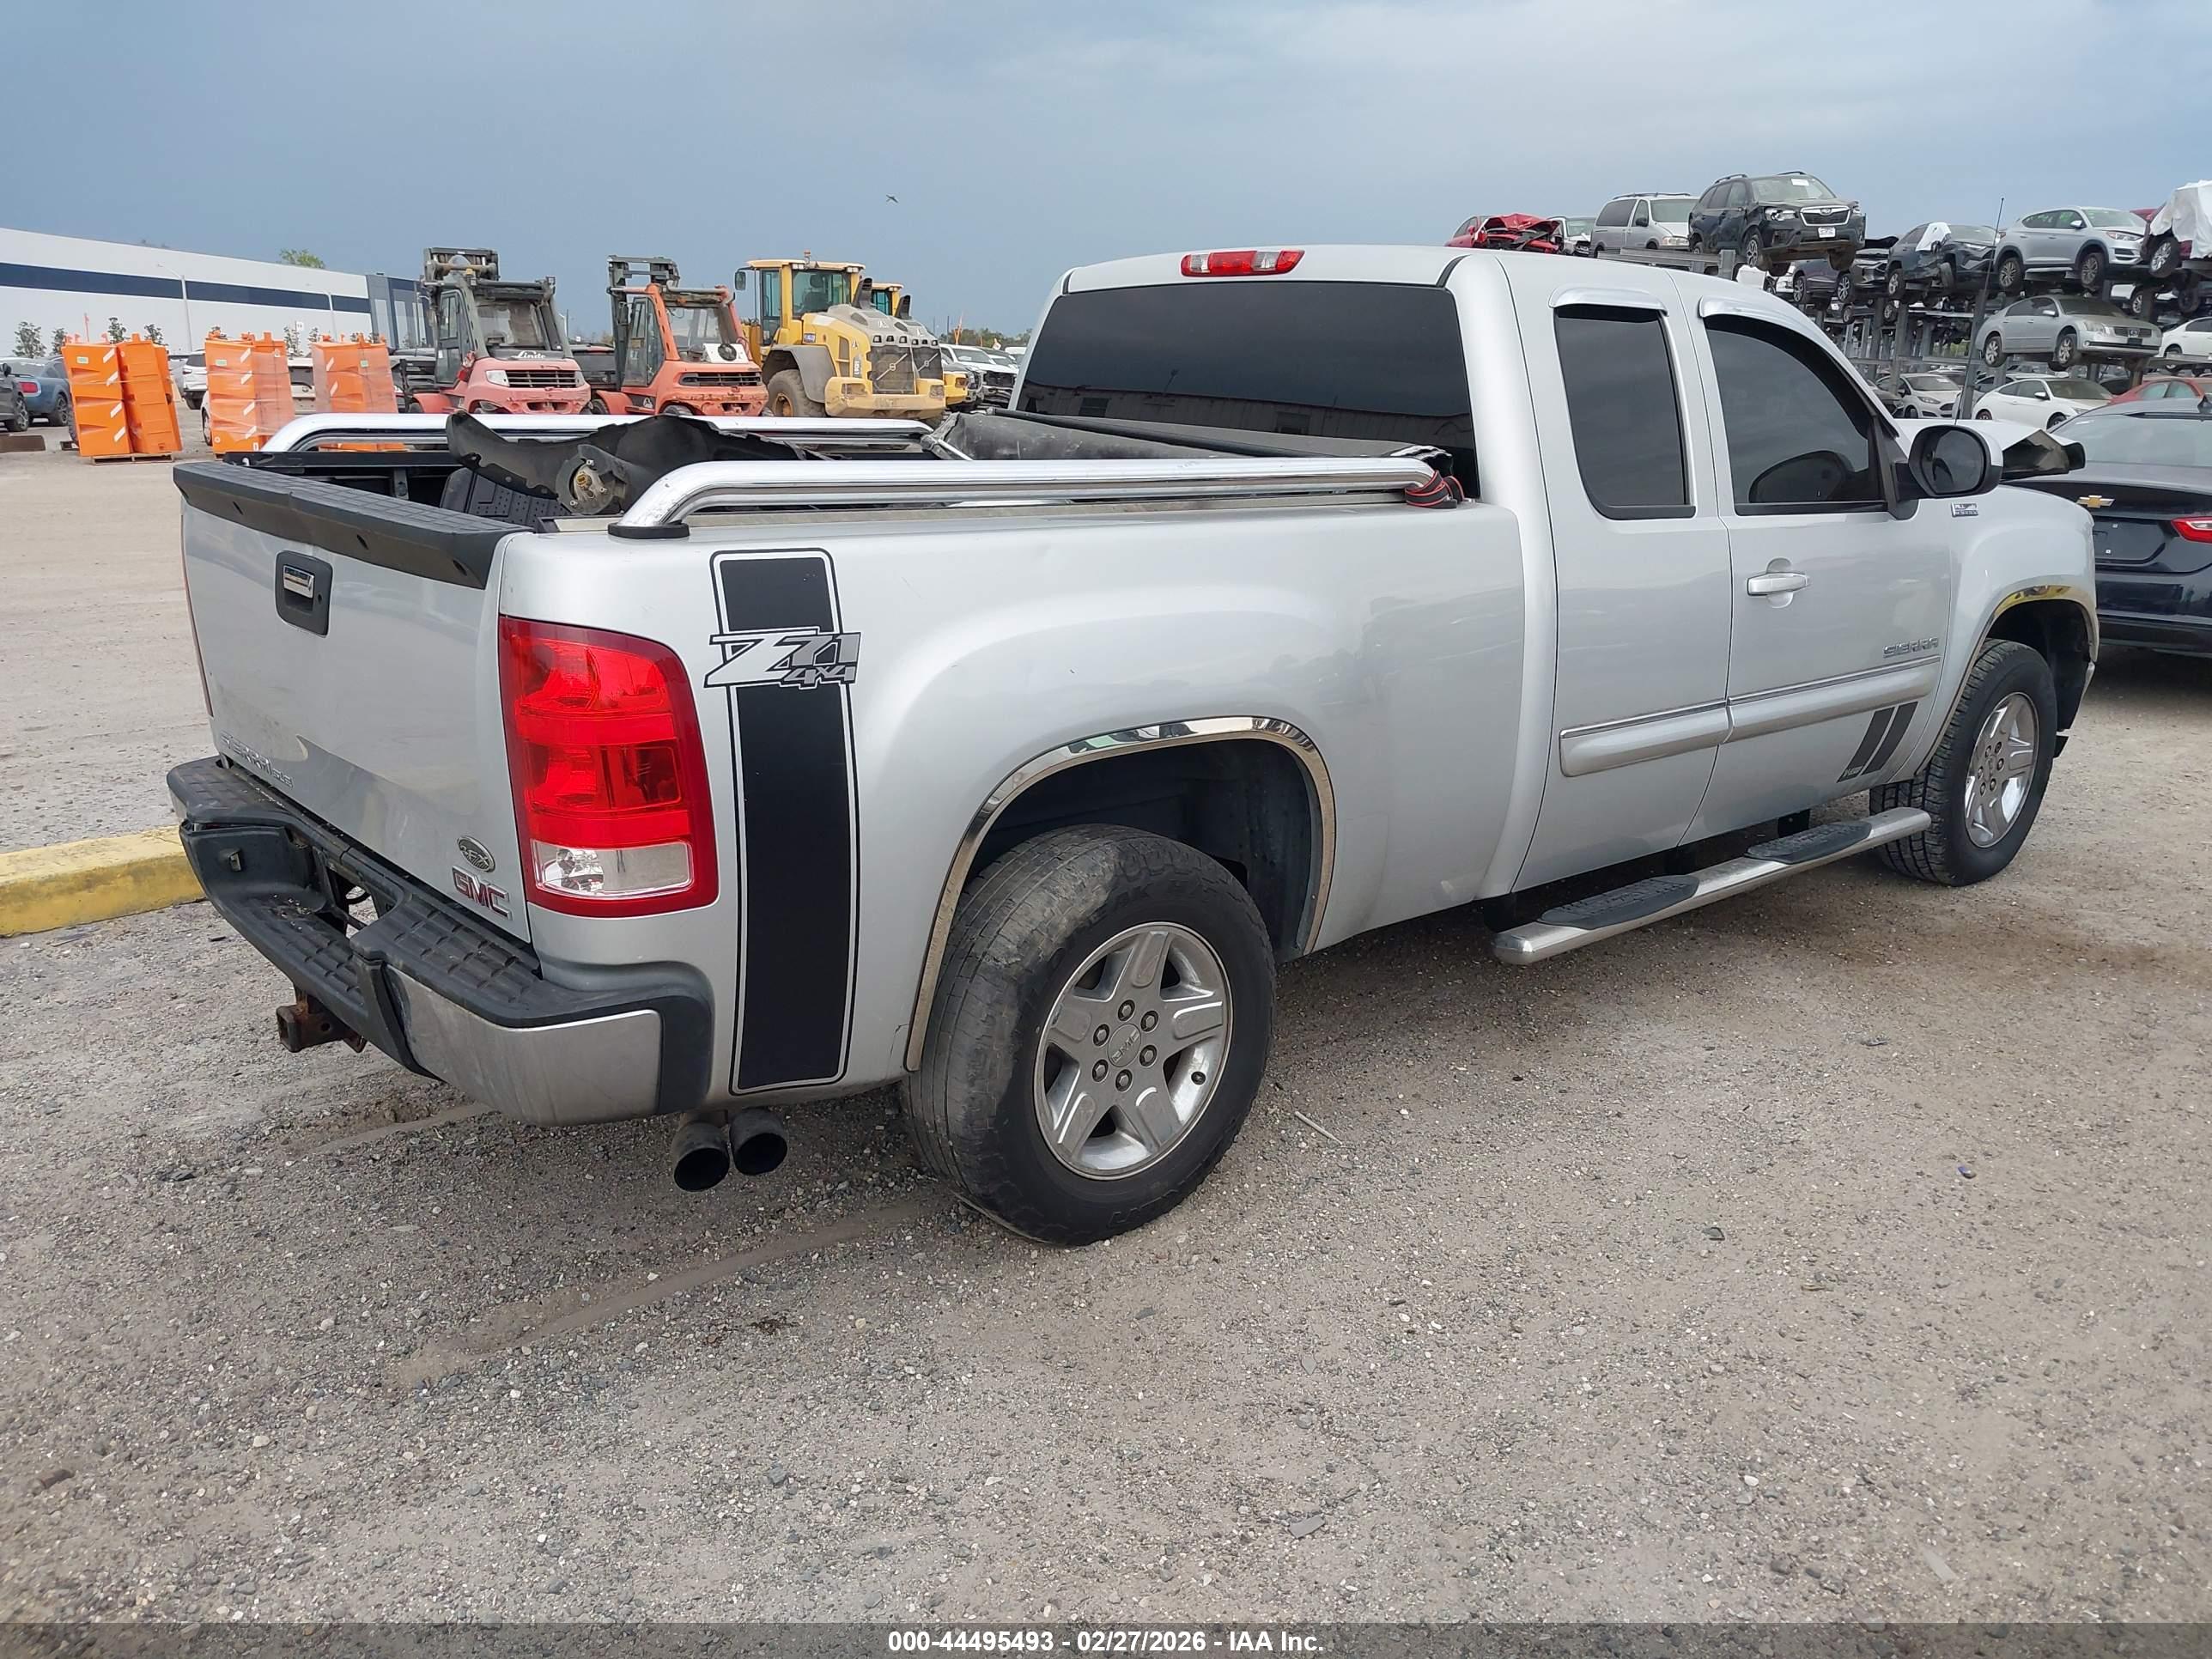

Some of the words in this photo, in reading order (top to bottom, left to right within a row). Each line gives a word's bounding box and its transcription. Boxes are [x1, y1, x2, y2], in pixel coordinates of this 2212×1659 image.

[510, 349, 547, 359] Linde
[706, 629, 859, 685] Z71
[1882, 636, 1939, 658] SIERRA
[220, 729, 272, 775] SIERRA
[452, 865, 514, 921] GMC
[1110, 1029, 1140, 1064] GMC
